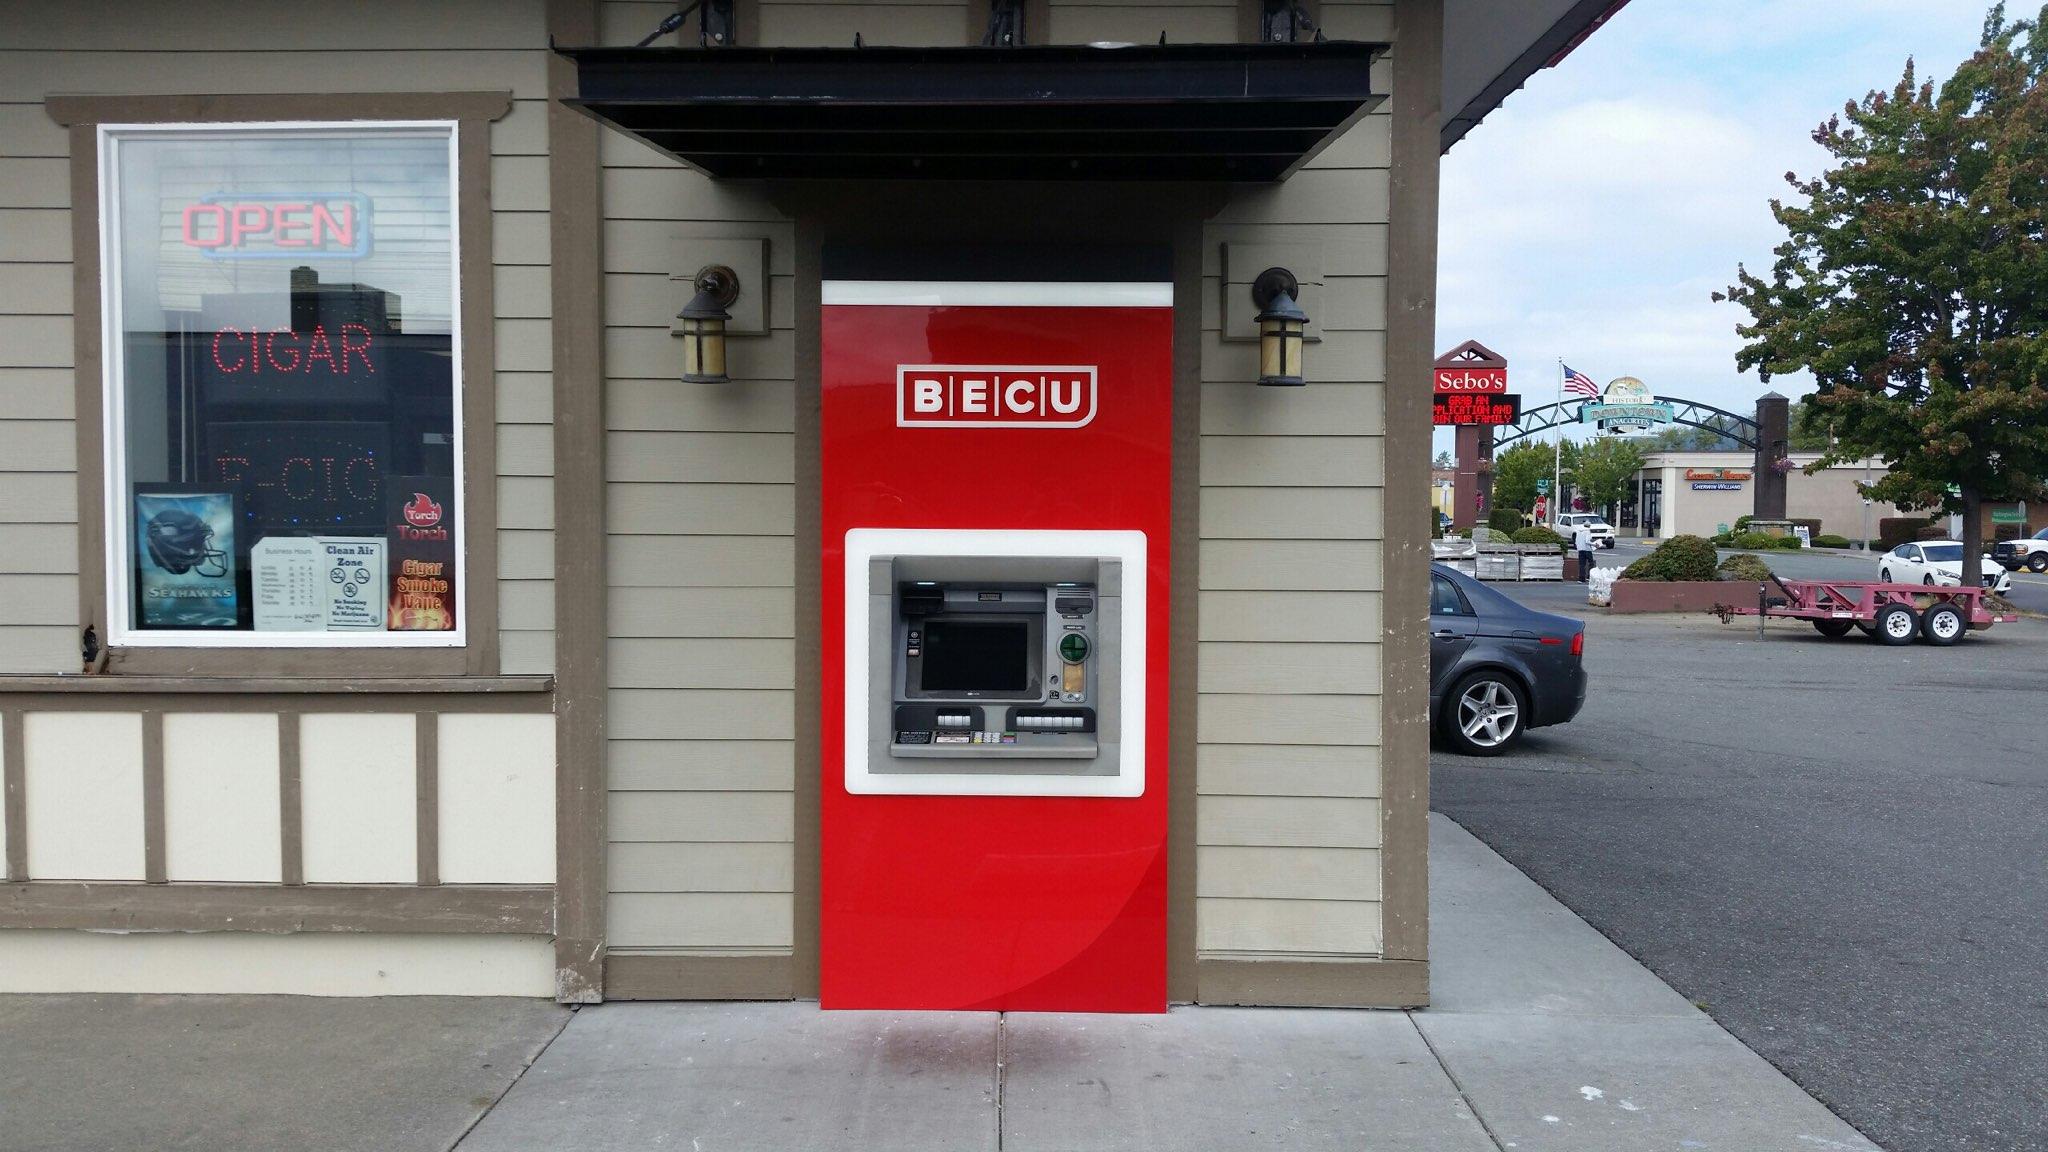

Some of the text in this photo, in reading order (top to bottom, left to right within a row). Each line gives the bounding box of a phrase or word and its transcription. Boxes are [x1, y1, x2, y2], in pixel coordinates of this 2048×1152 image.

[182, 204, 354, 247] OPEN
[212, 324, 376, 374] CIGAR
[1440, 372, 1503, 389] Sebo's
[914, 380, 1081, 413] BECU
[1449, 395, 1490, 405] GRAB AN
[1433, 405, 1513, 415] PPLICATION AND
[1591, 406, 1667, 419] DOWNTOWN
[1433, 415, 1512, 424] OIN OUR FAMILY
[1608, 417, 1650, 427] ANACORTES
[408, 510, 438, 520] Torch
[397, 525, 449, 541] Torch
[326, 545, 374, 555] Clean Air
[337, 558, 363, 567] Zone
[402, 559, 443, 577] Cigar
[397, 577, 448, 593] Smoke
[148, 587, 232, 598] SEAHAWKS
[403, 594, 442, 611] Vape
